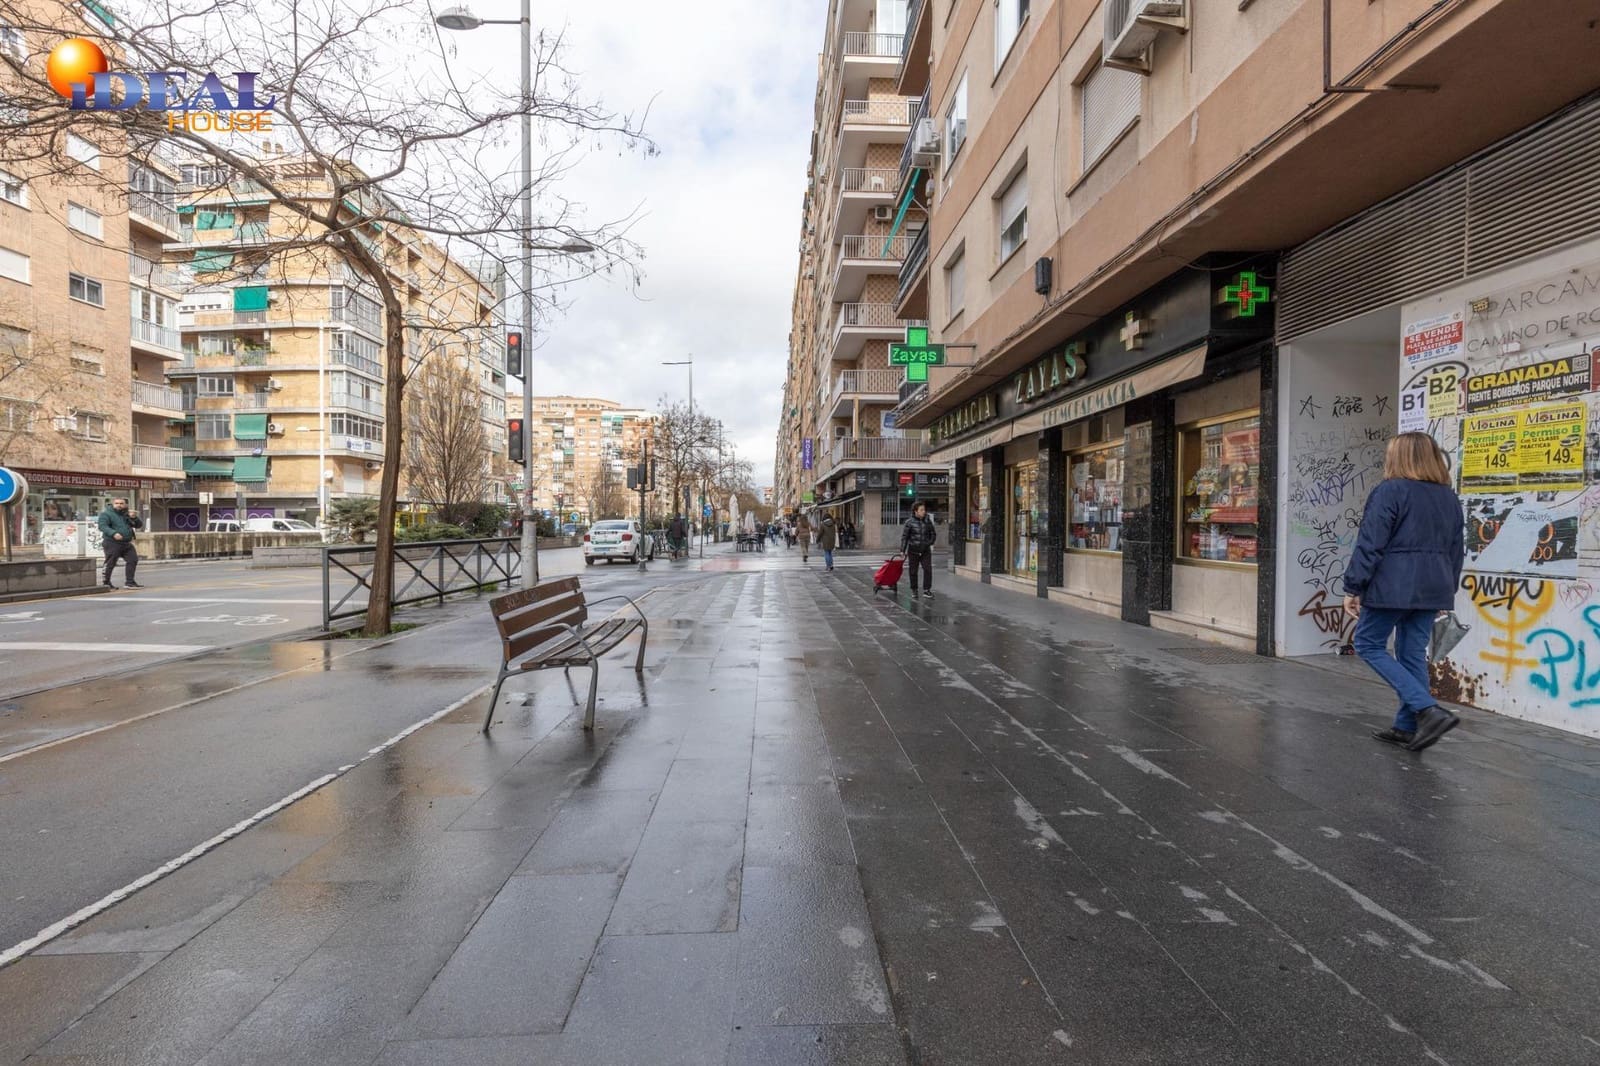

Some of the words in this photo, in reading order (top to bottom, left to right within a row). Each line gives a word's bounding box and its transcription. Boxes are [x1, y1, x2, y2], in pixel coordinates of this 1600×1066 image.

[1409, 333, 1422, 344] SE
[1423, 323, 1458, 339] VENDE
[1467, 323, 1539, 353] CAMINO
[1545, 315, 1570, 334] DE
[892, 347, 937, 362] Zayas
[1429, 374, 1457, 396] B2
[1469, 360, 1570, 392] GRANADA
[937, 392, 993, 440] FARMACIA
[1013, 341, 1086, 405] ZAYAS
[1468, 390, 1492, 403] FRENTE
[1531, 376, 1561, 393] PARQUE
[1562, 371, 1589, 386] NORTE
[1402, 391, 1425, 411] B1
[1469, 419, 1516, 431] MOLINA
[1525, 411, 1580, 425] MOLINA
[1466, 434, 1506, 444] Permiso
[1509, 432, 1516, 440] B
[1522, 427, 1569, 438] Permiso
[1572, 425, 1582, 433] B
[804, 439, 812, 470] HOSTAL
[24, 472, 62, 484] PRODUCTOS
[62, 475, 71, 484] DE
[71, 475, 106, 486] PELUQUERIA
[115, 479, 139, 488] ESTETICA
